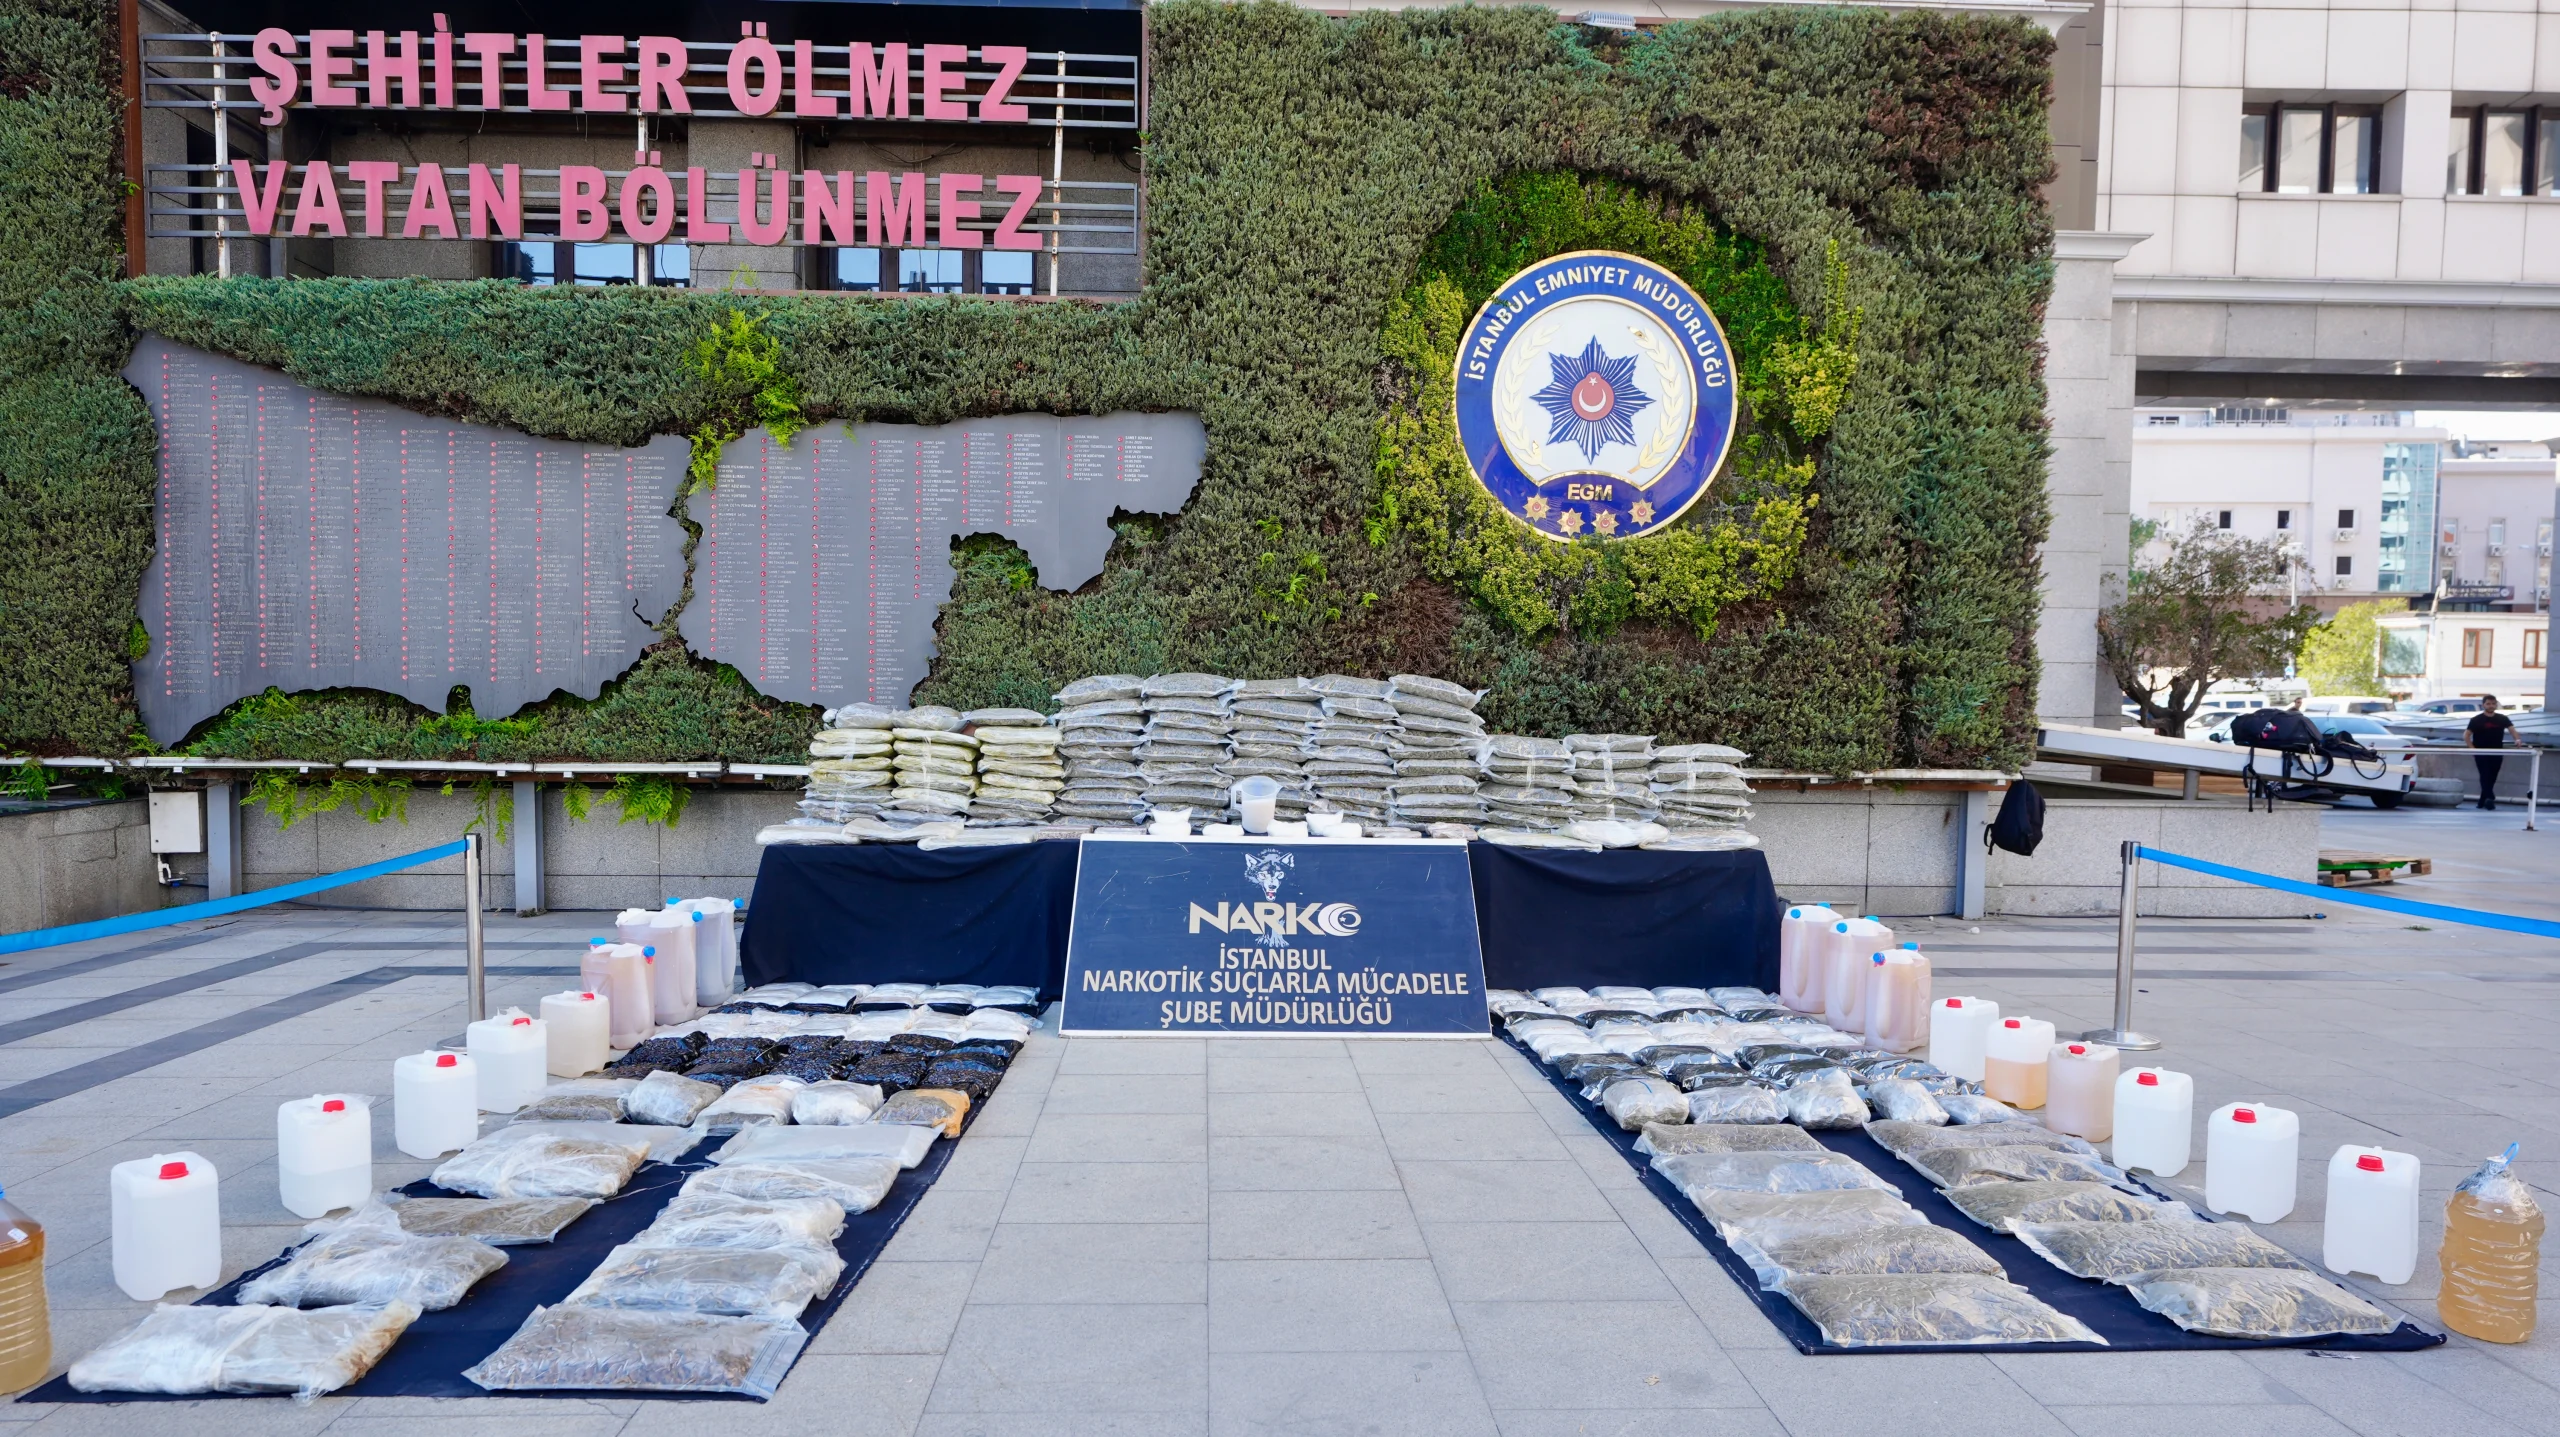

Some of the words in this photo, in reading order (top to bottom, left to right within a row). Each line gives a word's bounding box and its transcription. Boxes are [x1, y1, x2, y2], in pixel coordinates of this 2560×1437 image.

[250, 13, 693, 127] ŞEHİTLER
[726, 21, 1029, 122] ÖLMEZ
[230, 160, 523, 241] VATAN
[559, 151, 1044, 250] BÖLÜNMEZ
[1464, 290, 1536, 381] İSTANBUL
[1535, 263, 1630, 296] EMNİYET
[1632, 273, 1727, 389] MÜDÜRLÜĞÜ
[1567, 483, 1613, 501] EGM
[1219, 942, 1332, 971] İSTANBUL
[1082, 965, 1205, 993] NARKOTİK
[1209, 970, 1331, 999] SUÇLARLA
[1337, 967, 1469, 995] MÜCADELE
[1160, 1000, 1223, 1029] ŞUBE
[1230, 994, 1392, 1025] MÜDÜRLÜĞÜ
